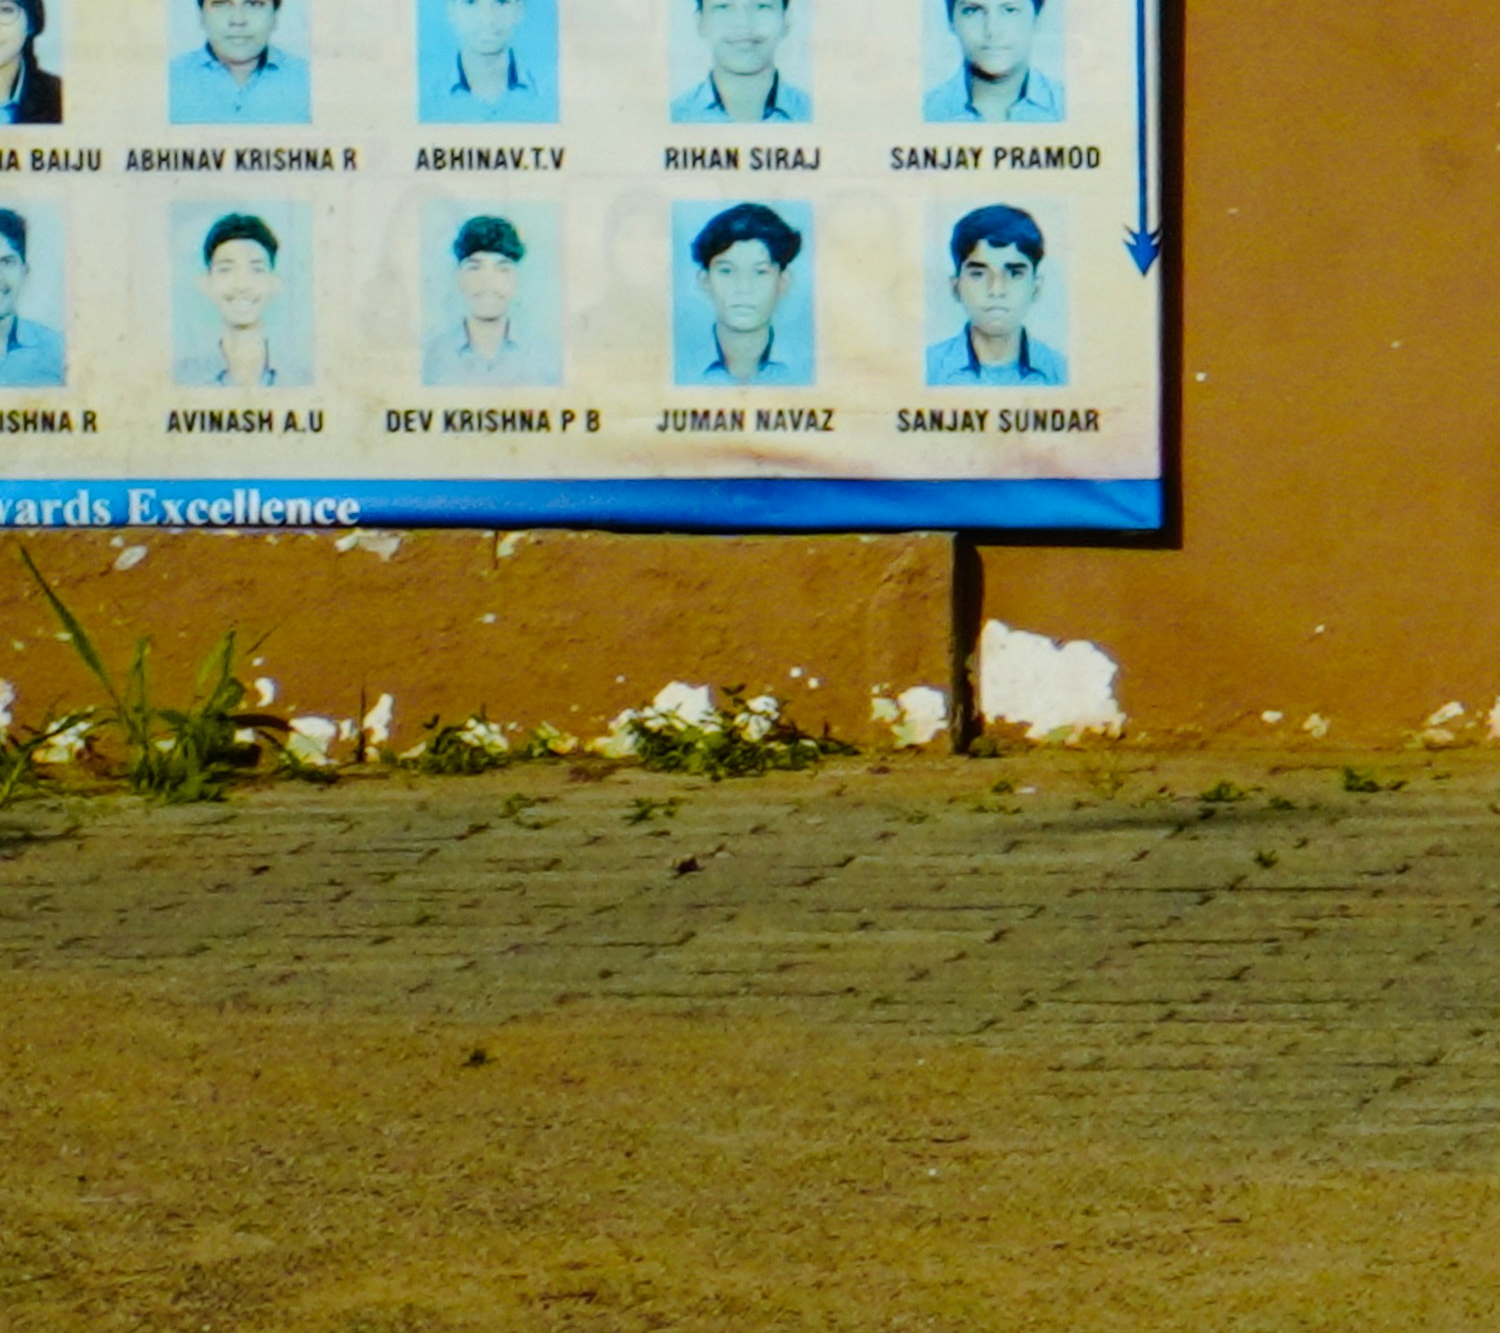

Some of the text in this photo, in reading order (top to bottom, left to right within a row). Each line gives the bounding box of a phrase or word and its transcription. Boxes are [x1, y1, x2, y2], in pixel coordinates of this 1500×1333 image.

[31, 149, 101, 171] BAIJU
[126, 148, 356, 171] ABHINAV KRISHNA R
[416, 148, 563, 170] ABHINAV.T.V
[666, 147, 820, 171] RIHAN SIRAJ
[891, 146, 1100, 170] SANJAY PRAMOD
[83, 410, 97, 432] R
[167, 410, 323, 433] AVINASH A.U
[387, 409, 600, 433] DEV KRISHNA P B
[657, 409, 834, 432] JUMAN NAVAZ
[898, 409, 1099, 433] SANJAY SUNDAR
[128, 488, 360, 525] Excellence
